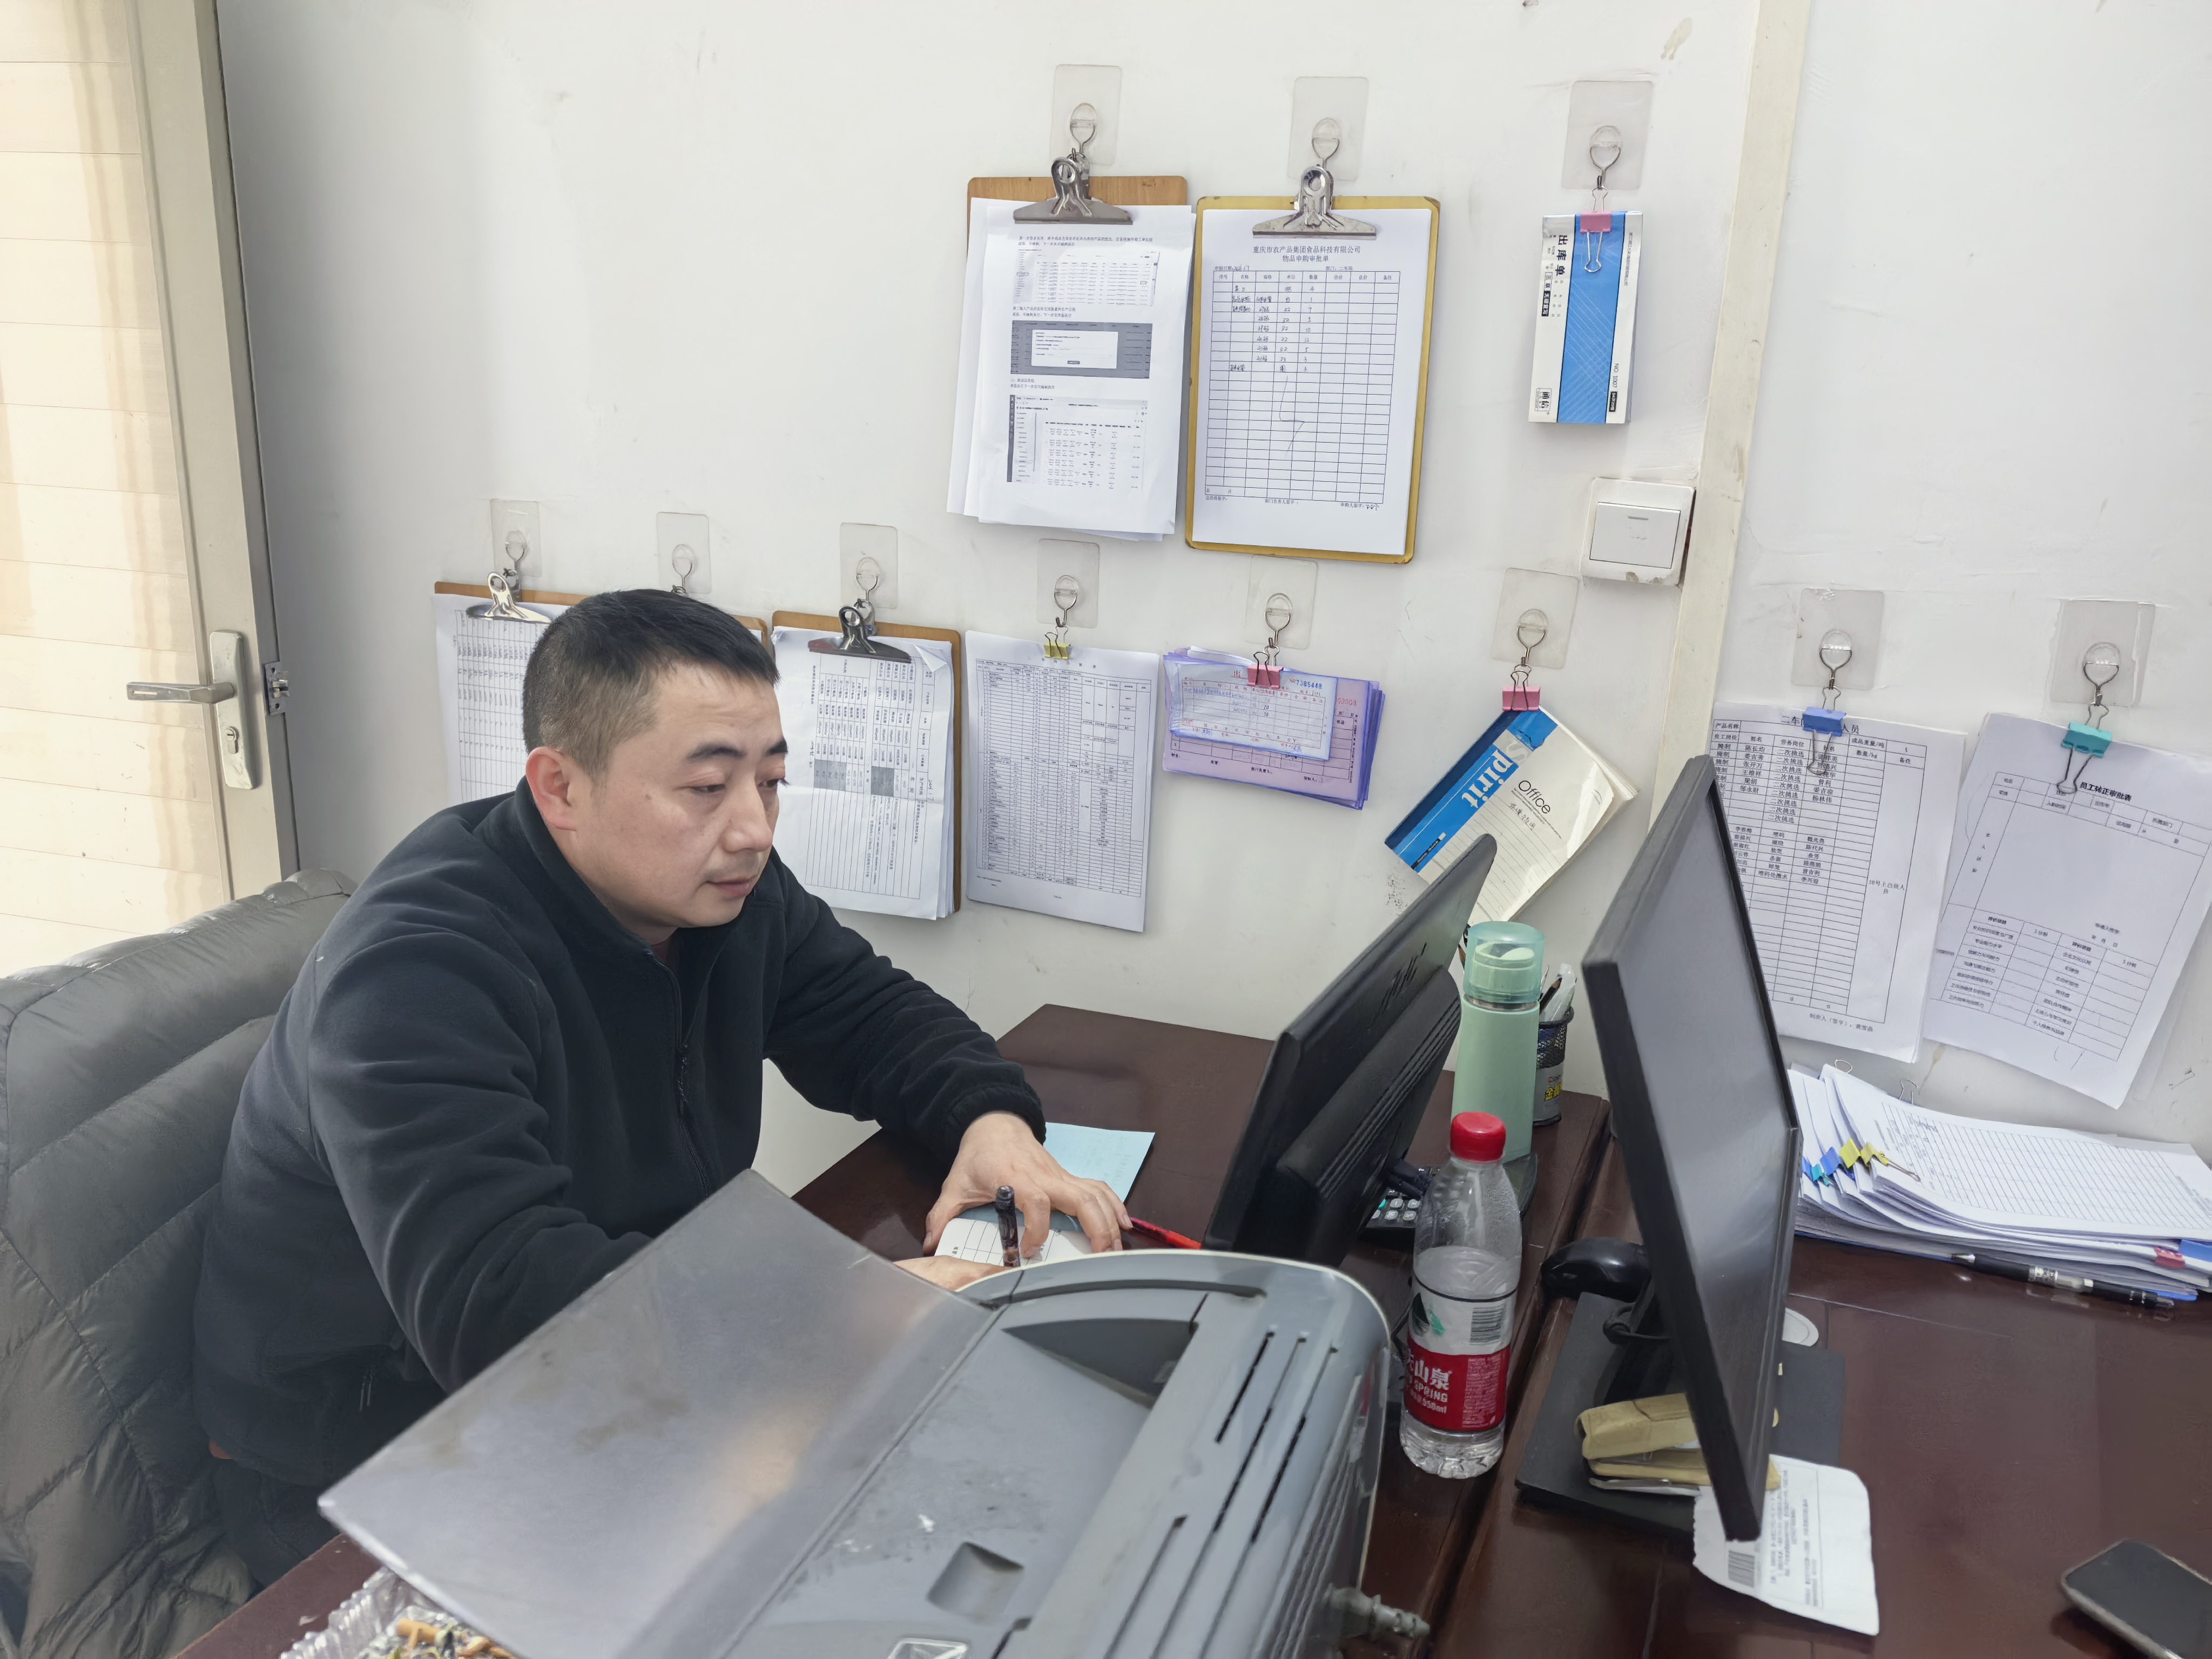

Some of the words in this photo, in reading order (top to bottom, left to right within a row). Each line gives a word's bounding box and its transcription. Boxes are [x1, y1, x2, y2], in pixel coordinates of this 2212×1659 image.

[1252, 245, 1361, 254] 重庆市农产品集团食品科技有限公司
[1282, 254, 1329, 262] 物品申购审批单
[1555, 234, 1568, 276] 出库单
[1781, 739, 1804, 747] 劳务岗位
[1777, 749, 1804, 758] 二次挑选
[1776, 757, 1803, 766] 二次挑选
[1775, 765, 1803, 774] 二次挑选
[1774, 773, 1801, 783] 二次挑选
[1773, 782, 1800, 791] 二次挑选
[1771, 790, 1798, 799] 二次挑选
[2080, 781, 2133, 802] 员工转正审批表
[1518, 780, 1551, 814] Office
[1770, 798, 1797, 807] 二次挑选
[1769, 806, 1796, 815] 二次挑选
[1768, 814, 1795, 824] 二次挑选
[1414, 1379, 1448, 1403] SPRING
